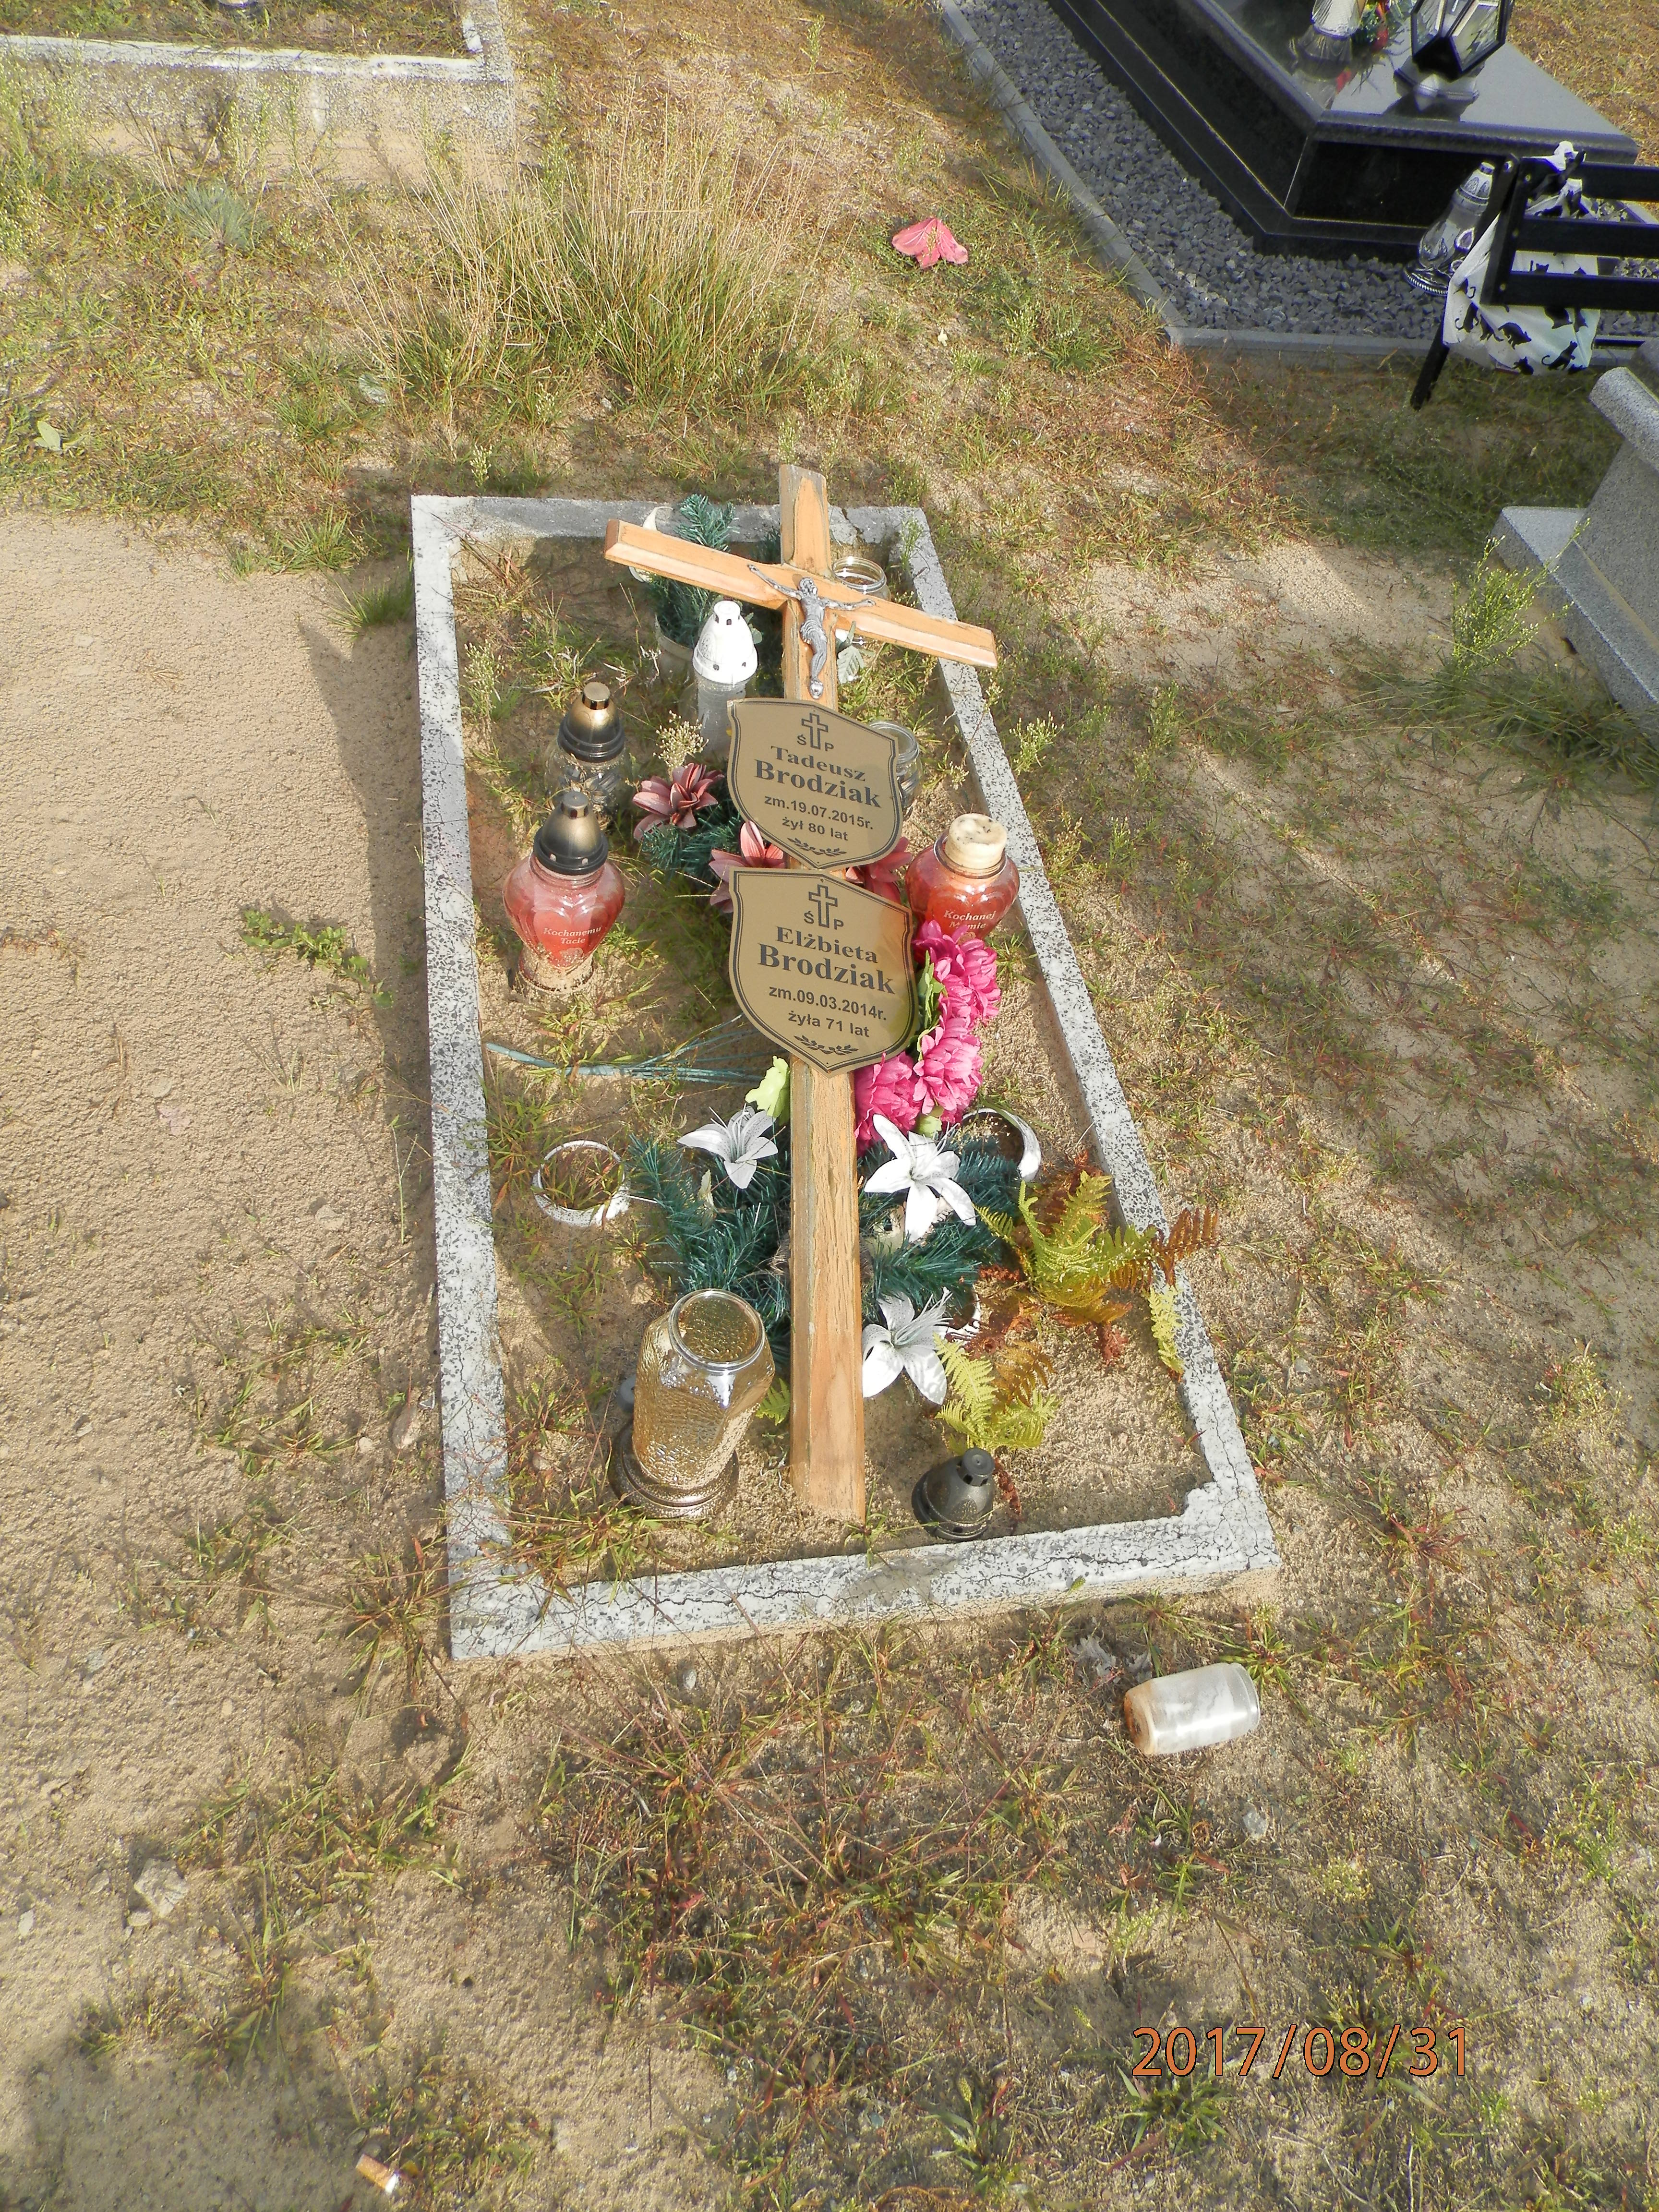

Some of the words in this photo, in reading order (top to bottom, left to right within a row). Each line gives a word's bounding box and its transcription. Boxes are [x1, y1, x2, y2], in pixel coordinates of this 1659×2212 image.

[797, 734, 806, 745] Ś
[825, 742, 834, 751] P
[770, 745, 866, 781] Tadeusz
[754, 759, 881, 808] Brodziak
[764, 795, 874, 830] zm.19.07.2015r.
[782, 817, 804, 830] żył
[808, 823, 825, 835] 80
[830, 828, 848, 841] lat
[804, 911, 815, 924] Ś
[834, 919, 844, 929] P
[943, 910, 996, 920] Kochanej
[949, 921, 986, 930] Mmie
[543, 926, 602, 937] Kochanemu
[775, 926, 878, 963] Elżbieta
[757, 943, 895, 995] Brodziak
[769, 986, 887, 1020] zm.09.03.2014r.
[788, 1010, 820, 1027] żyła
[826, 1018, 843, 1032] 71
[850, 1023, 870, 1037] lat
